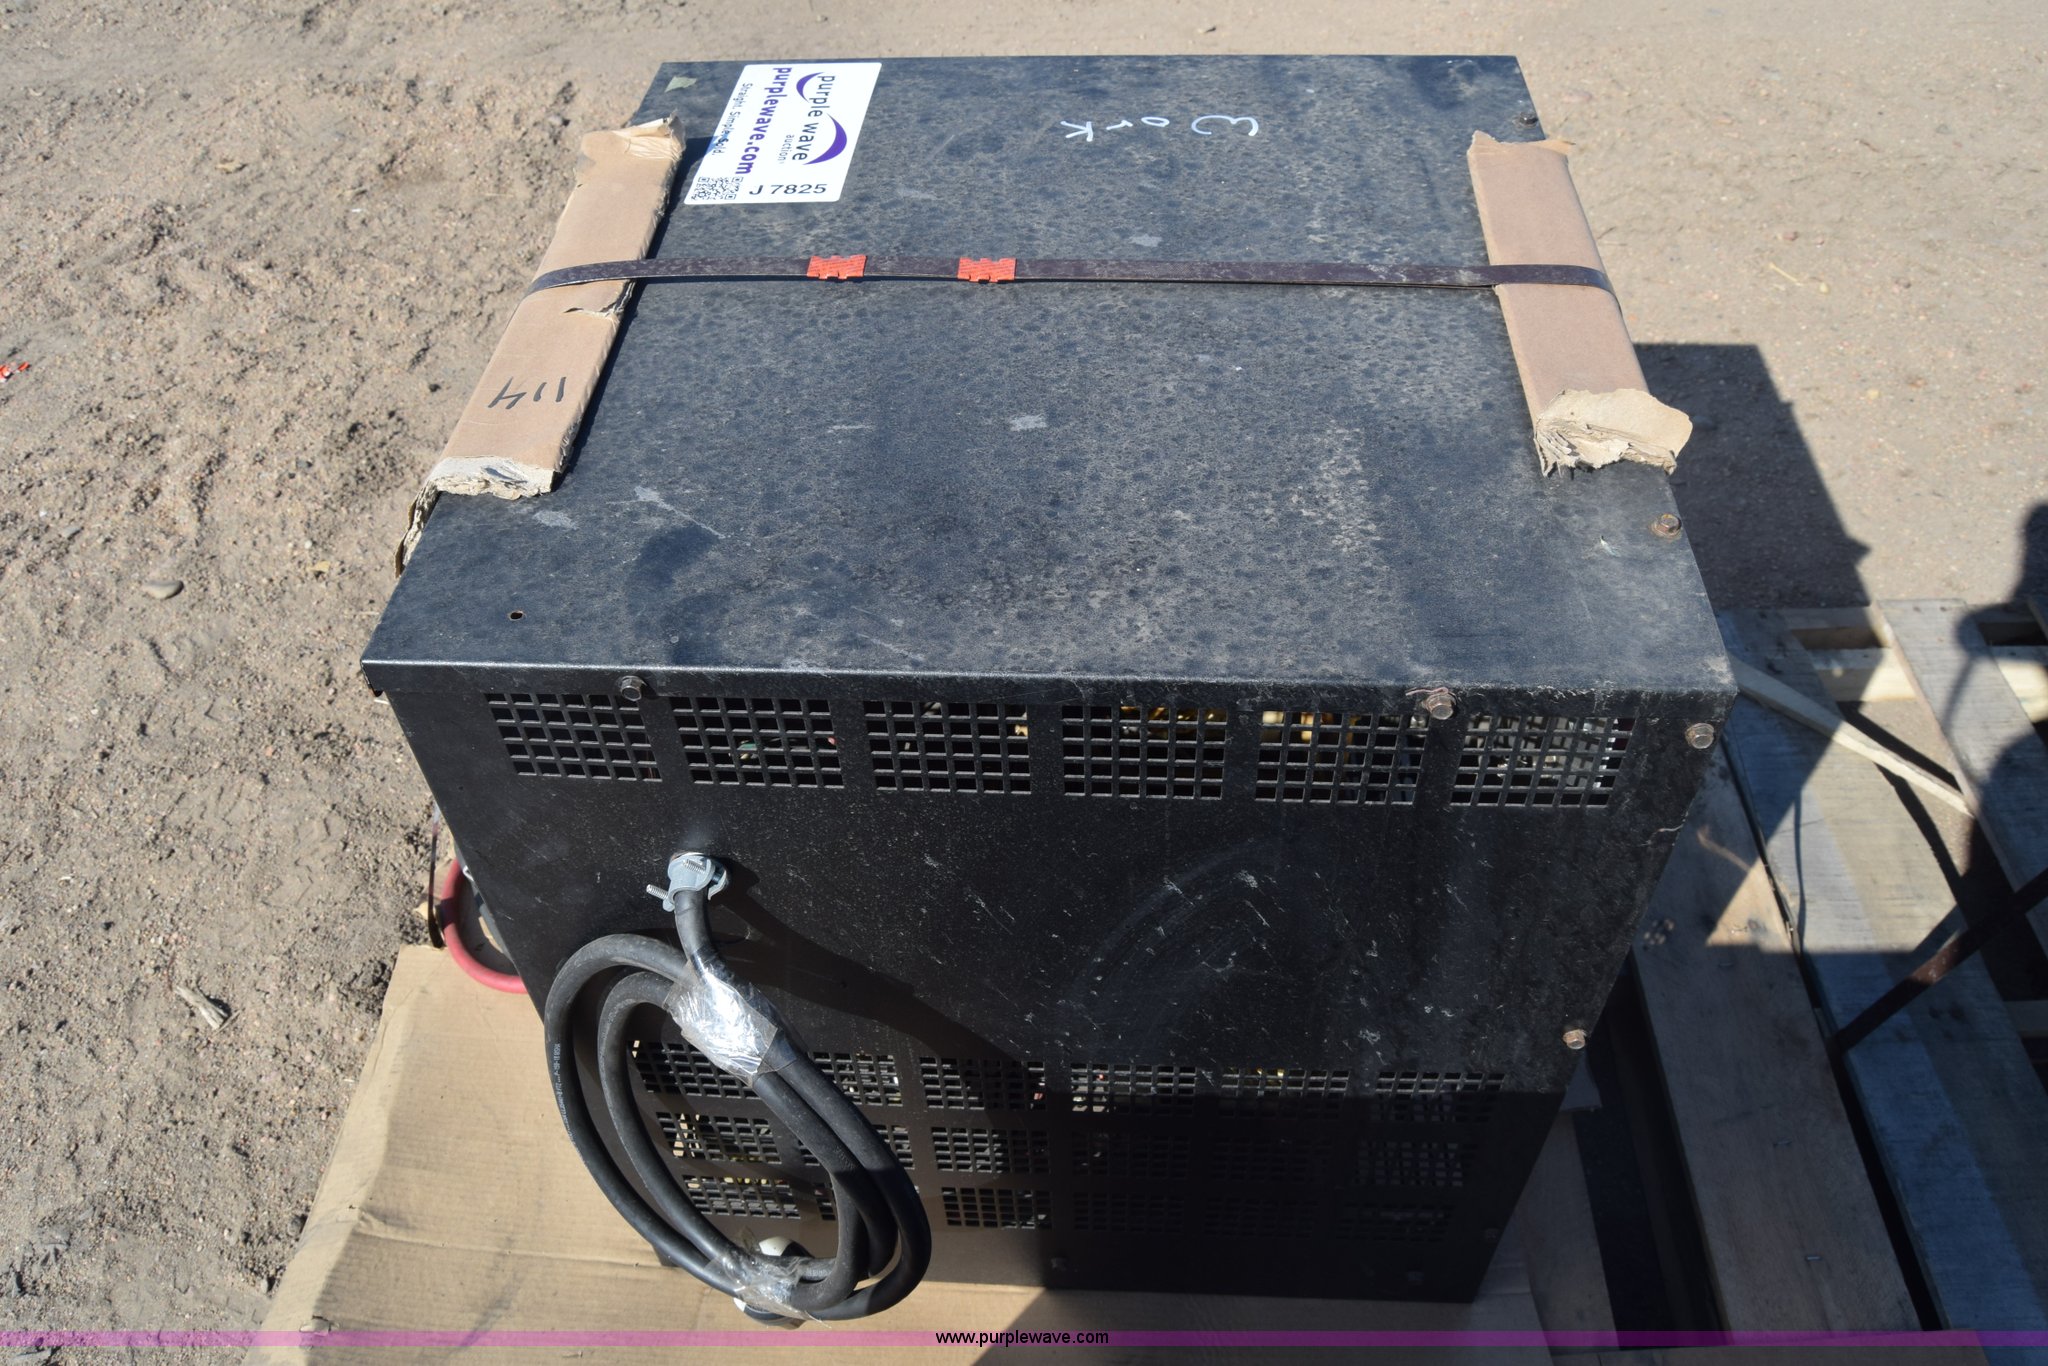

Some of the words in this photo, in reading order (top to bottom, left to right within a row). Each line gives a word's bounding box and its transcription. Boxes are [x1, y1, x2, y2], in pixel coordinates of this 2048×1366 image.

[808, 75, 835, 118] purple
[735, 67, 792, 174] purplewave.com
[792, 122, 819, 160] wave
[770, 184, 827, 195] 7825
[487, 377, 567, 409] 114
